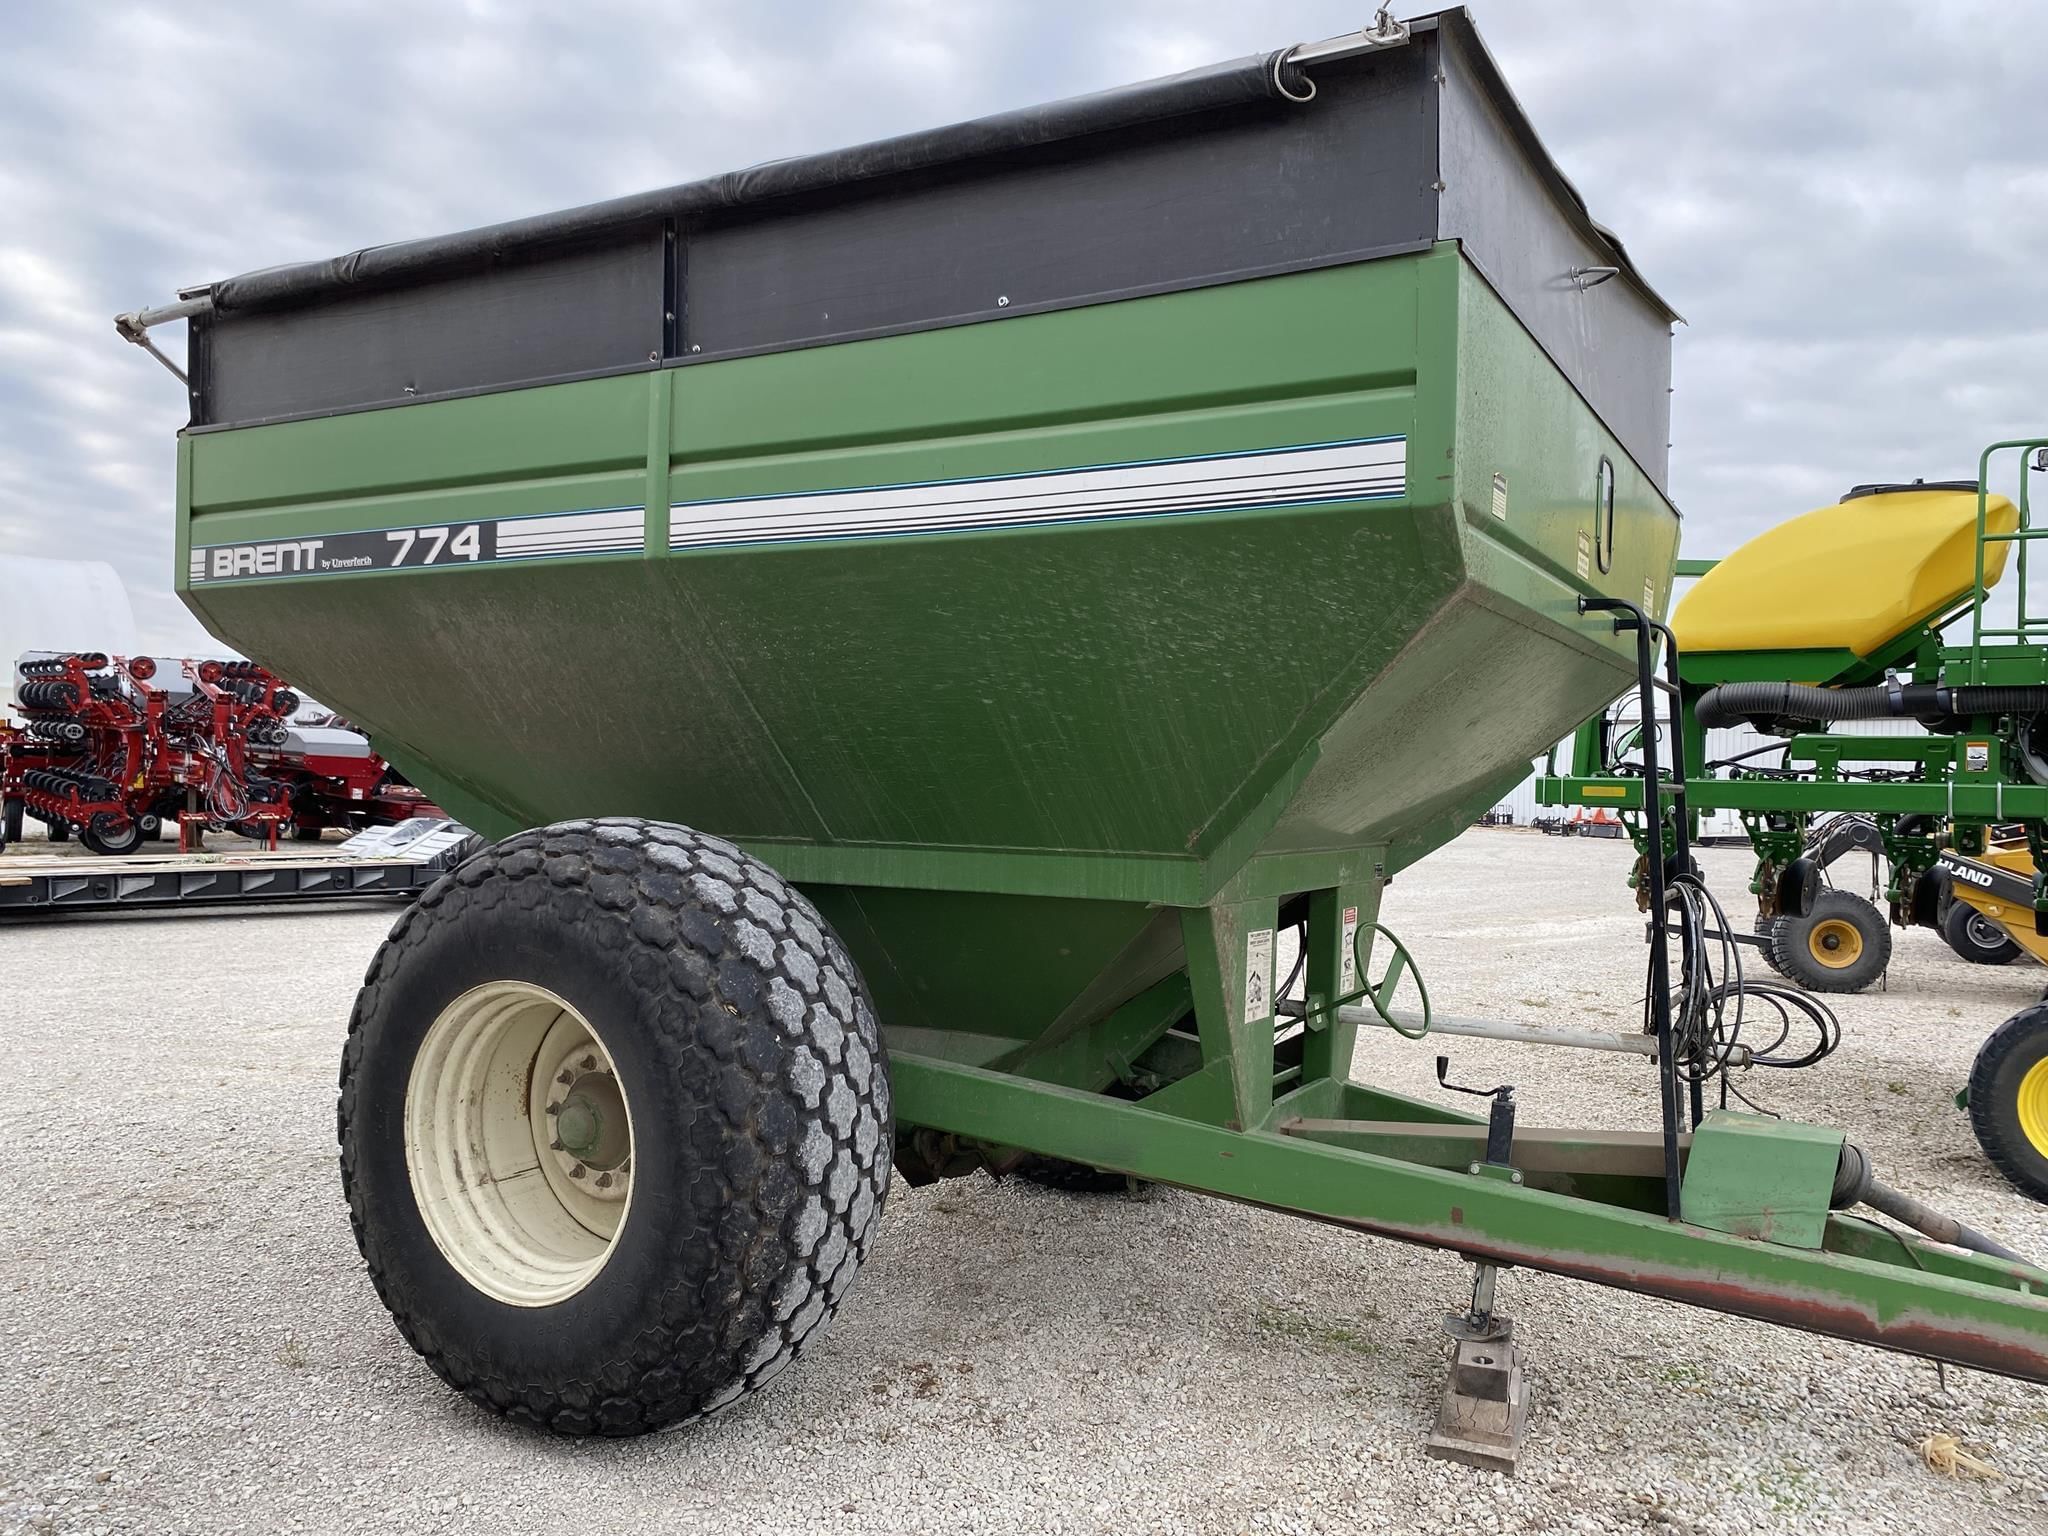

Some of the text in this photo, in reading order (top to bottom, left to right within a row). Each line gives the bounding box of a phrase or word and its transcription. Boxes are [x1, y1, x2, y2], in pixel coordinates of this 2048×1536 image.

[213, 540, 323, 578] BRENT
[321, 559, 331, 570] by
[386, 524, 481, 567] 774
